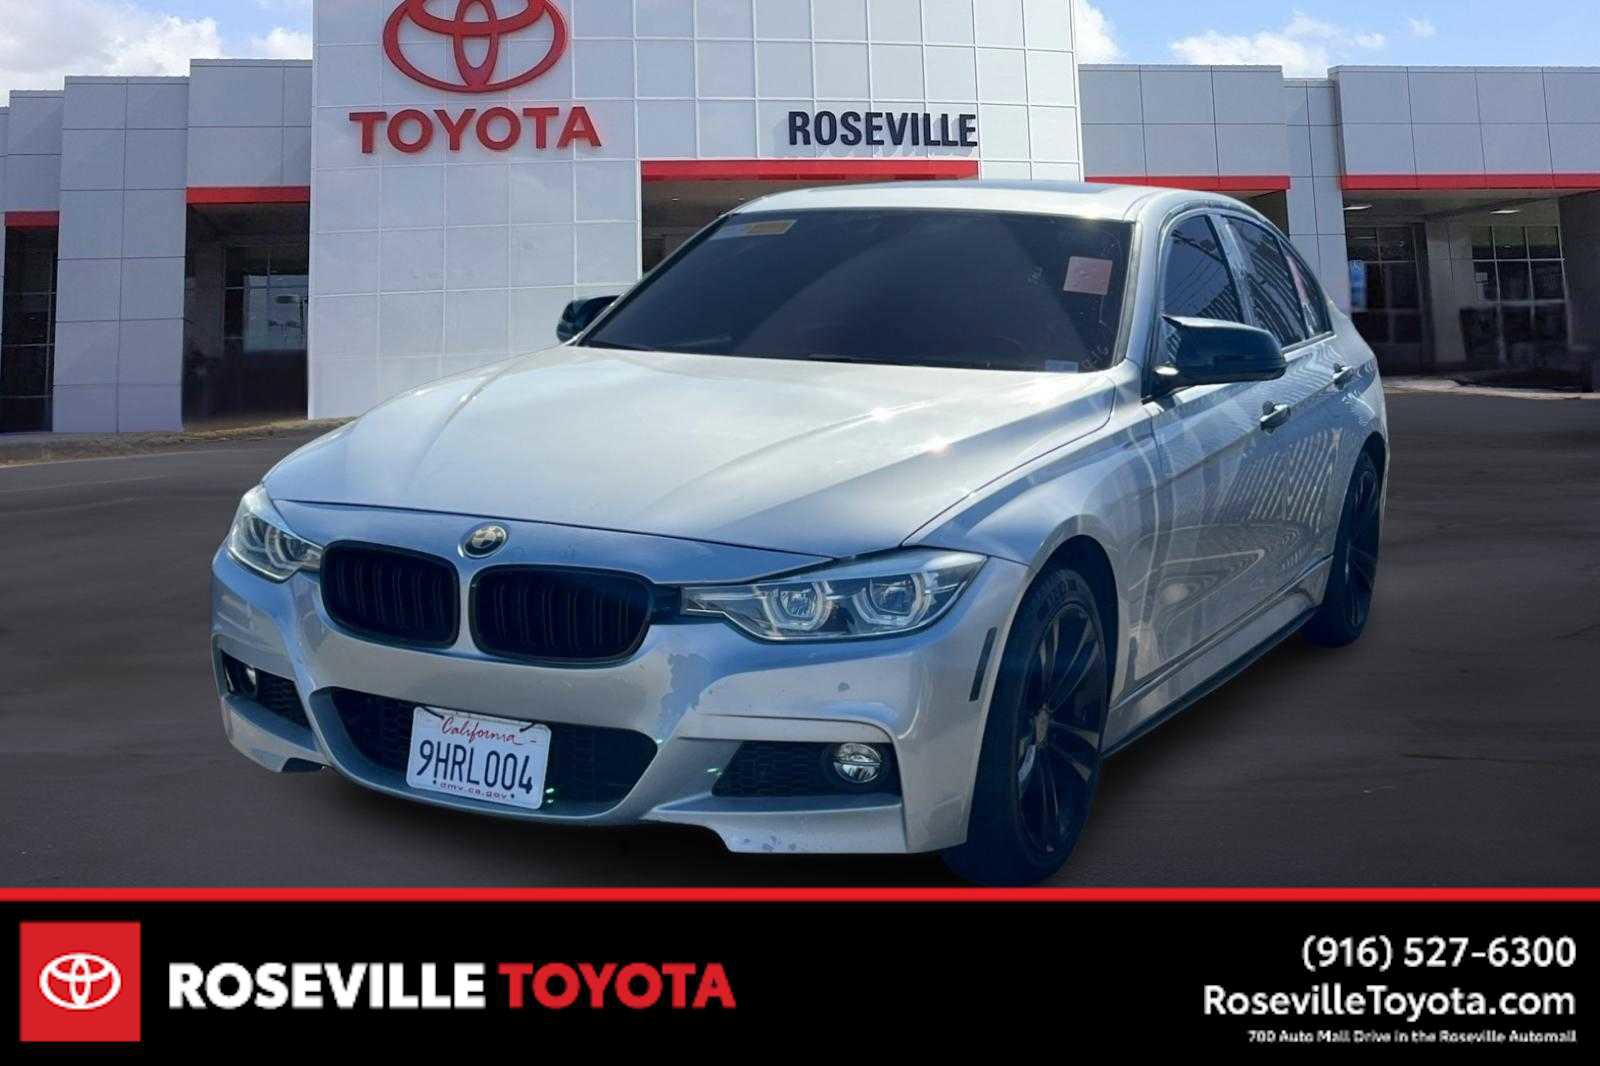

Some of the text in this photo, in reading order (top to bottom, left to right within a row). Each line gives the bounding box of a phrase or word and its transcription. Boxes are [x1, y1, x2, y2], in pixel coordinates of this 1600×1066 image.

[349, 106, 602, 154] TOYOTA
[788, 110, 979, 147] ROSEVILLE
[441, 716, 524, 746] California
[416, 739, 533, 794] 9HRL004
[440, 782, 508, 799] dmv.ca.gov
